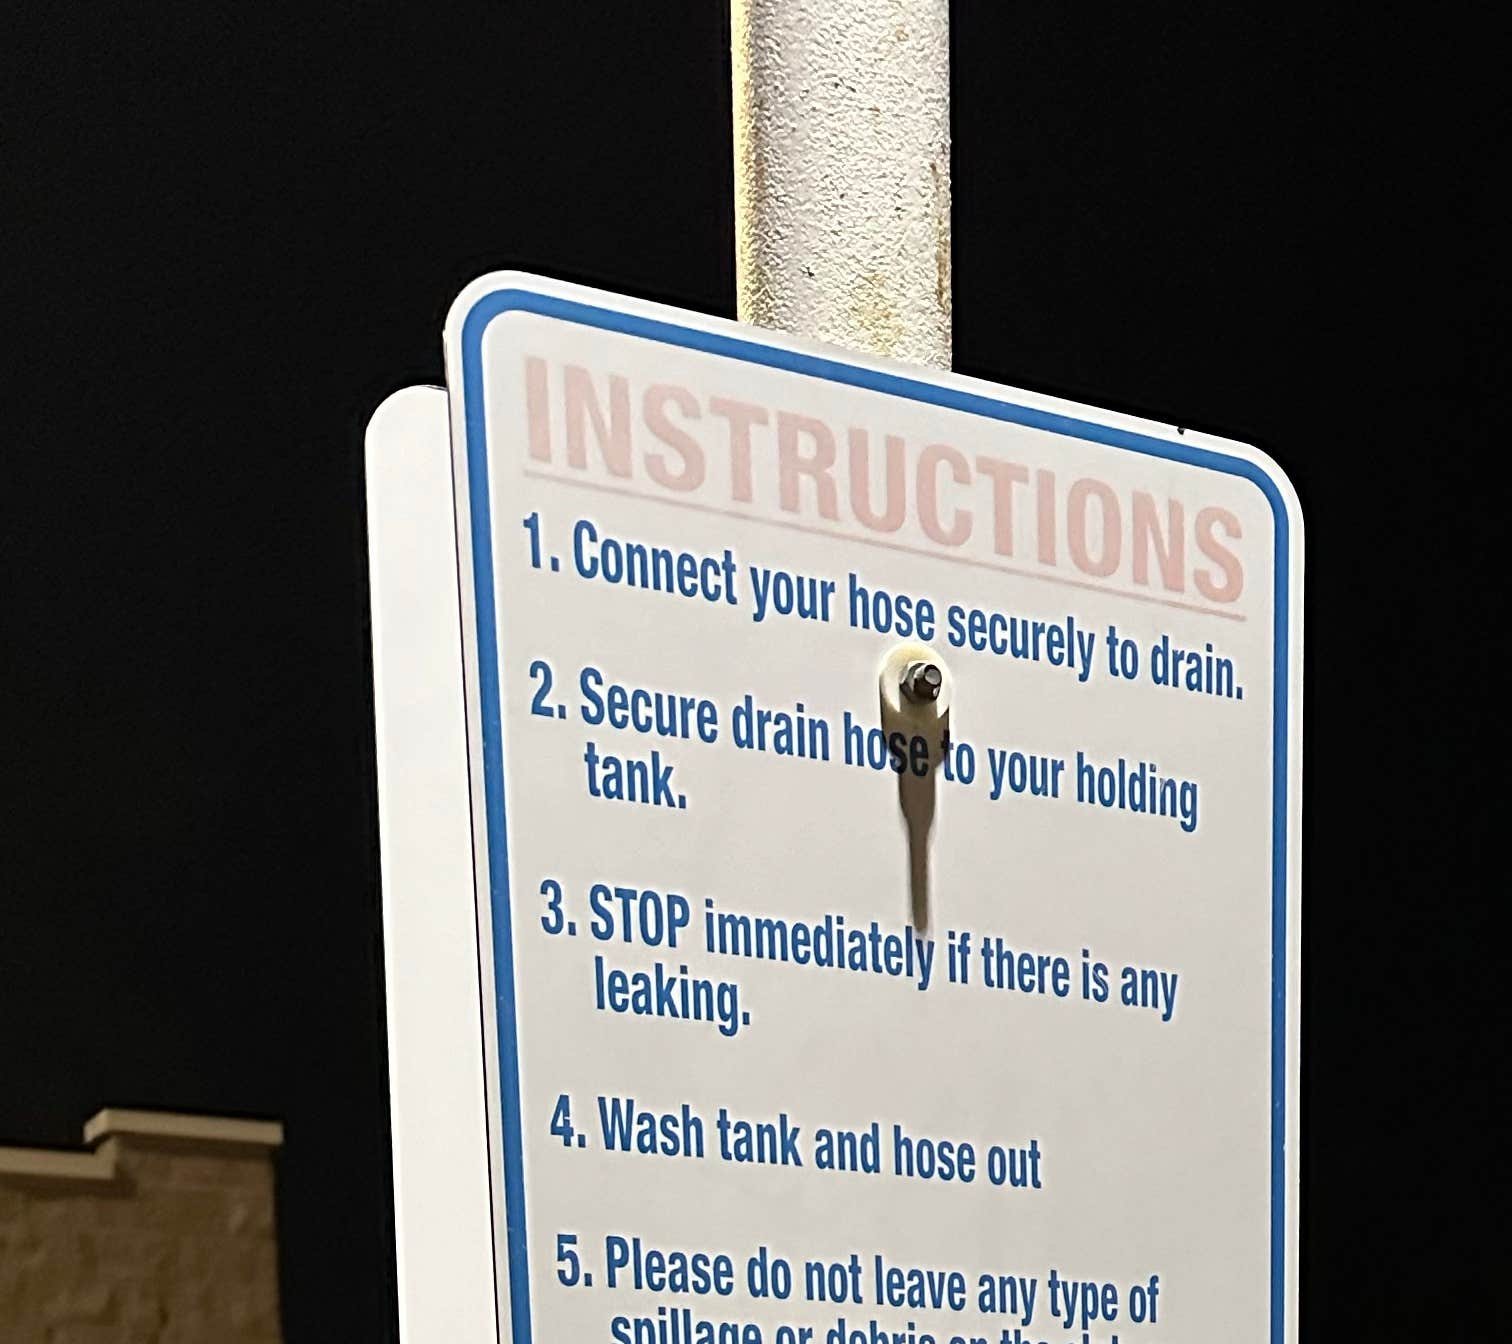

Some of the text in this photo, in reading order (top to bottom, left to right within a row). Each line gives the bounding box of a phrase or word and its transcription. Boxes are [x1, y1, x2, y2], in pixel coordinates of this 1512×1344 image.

[522, 356, 1245, 604] INSTRUCTIONS
[523, 511, 1243, 700] 1. Connect your hose securely to drain.
[529, 660, 1198, 833] 2. Secure drain hose to your holding
[583, 741, 687, 809] tank.
[540, 879, 1178, 1022] 3. STOP immediately if there is any
[594, 955, 750, 1037] leaking.
[550, 1094, 1042, 1189] 4. Wash tank and hose out
[557, 1233, 1159, 1331] 5. Please do not leave any type of
